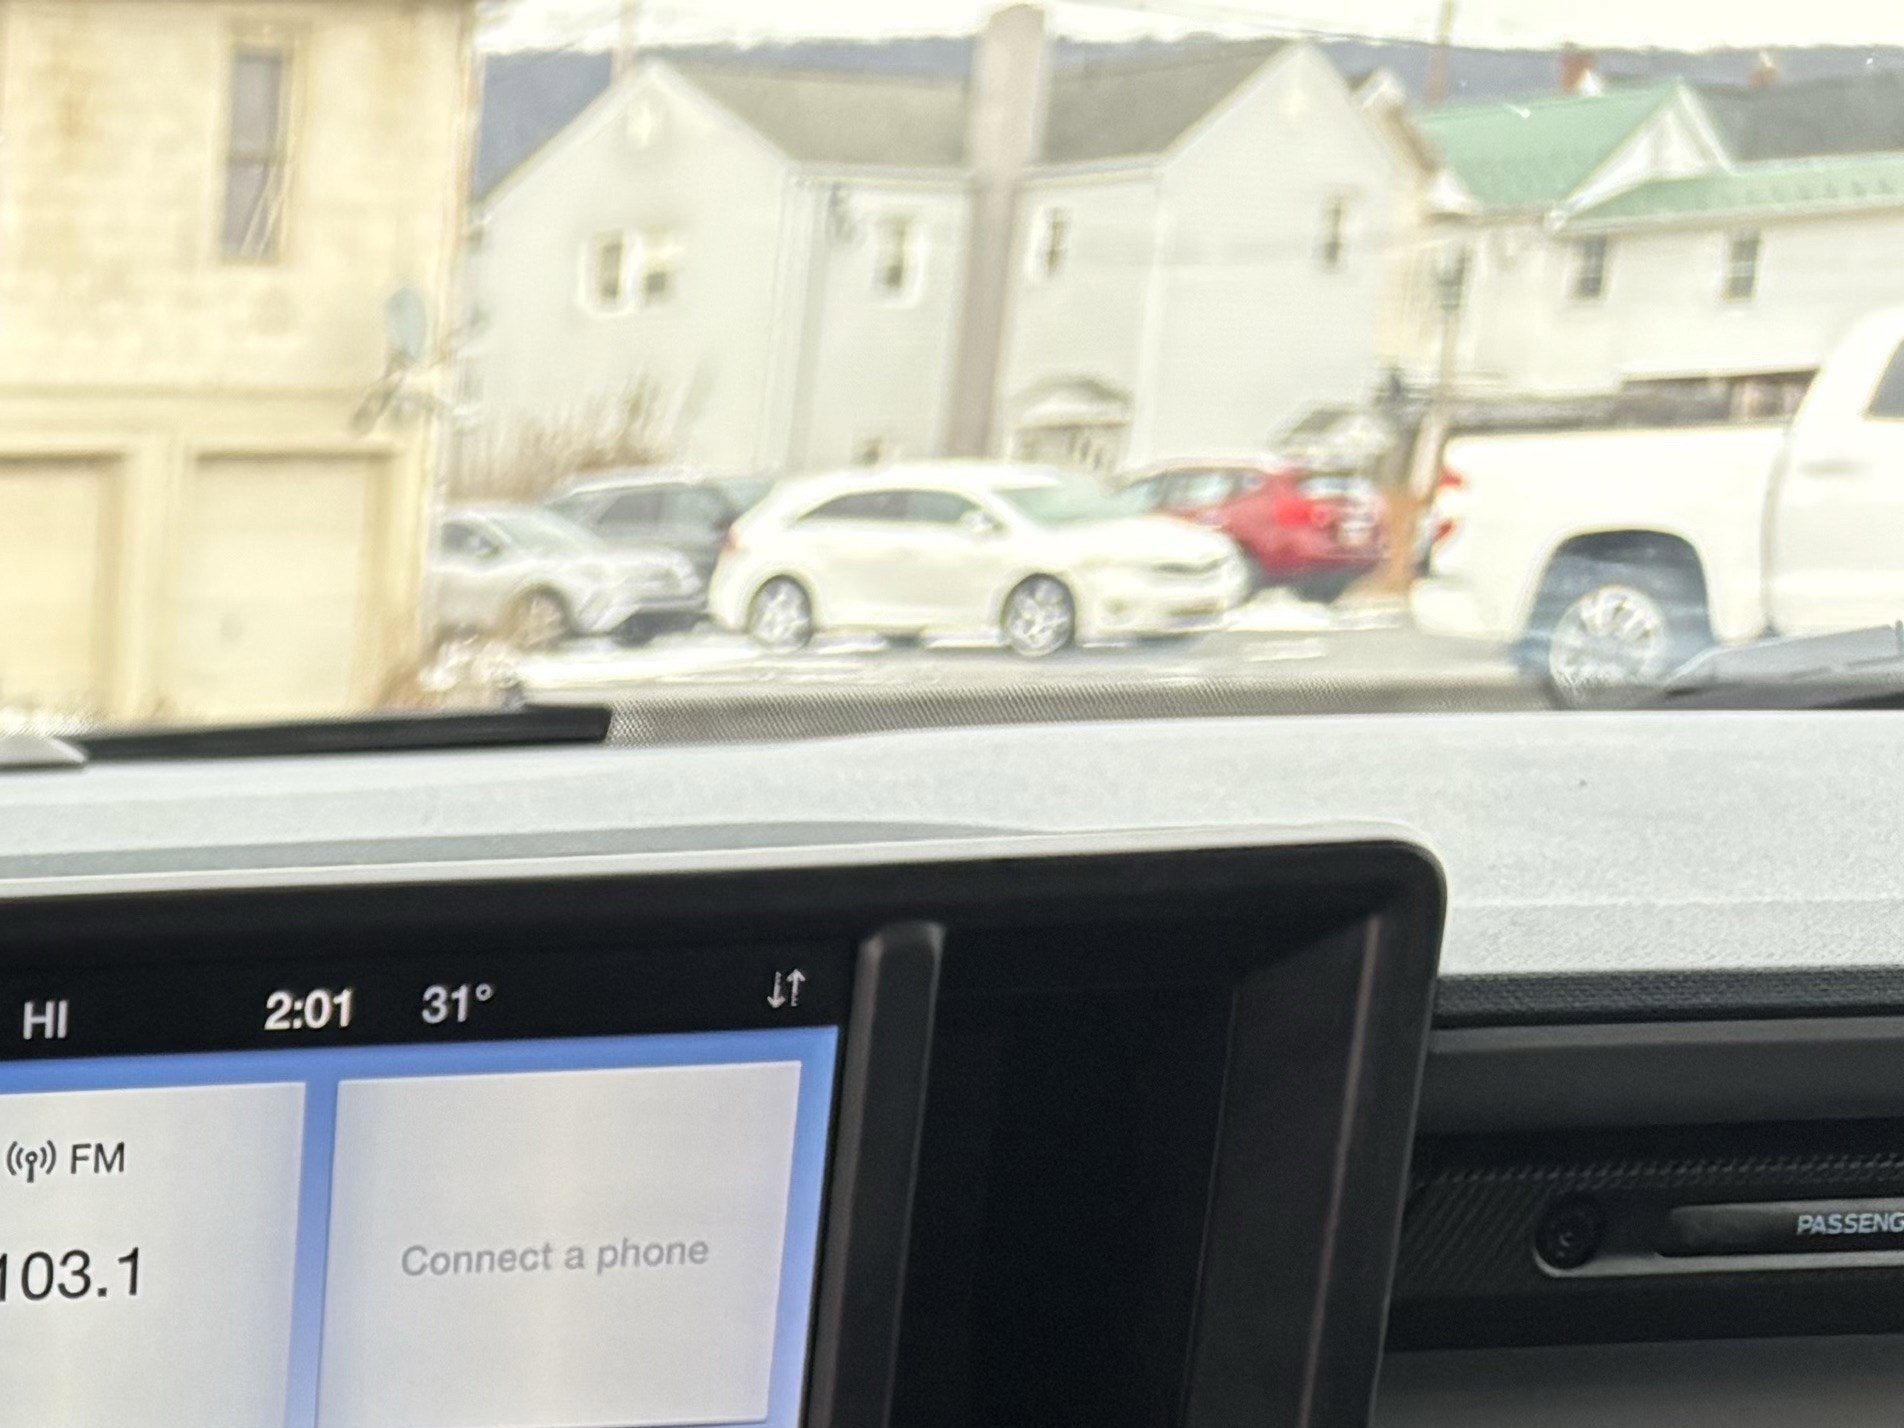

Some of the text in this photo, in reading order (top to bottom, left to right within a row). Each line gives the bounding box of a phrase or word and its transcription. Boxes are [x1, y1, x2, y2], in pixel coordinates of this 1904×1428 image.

[21, 1000, 69, 1041] HI
[264, 988, 355, 1032] 2:01
[421, 981, 495, 1026] 31°
[69, 1140, 128, 1177] FM
[400, 1233, 711, 1280] Connect a phone
